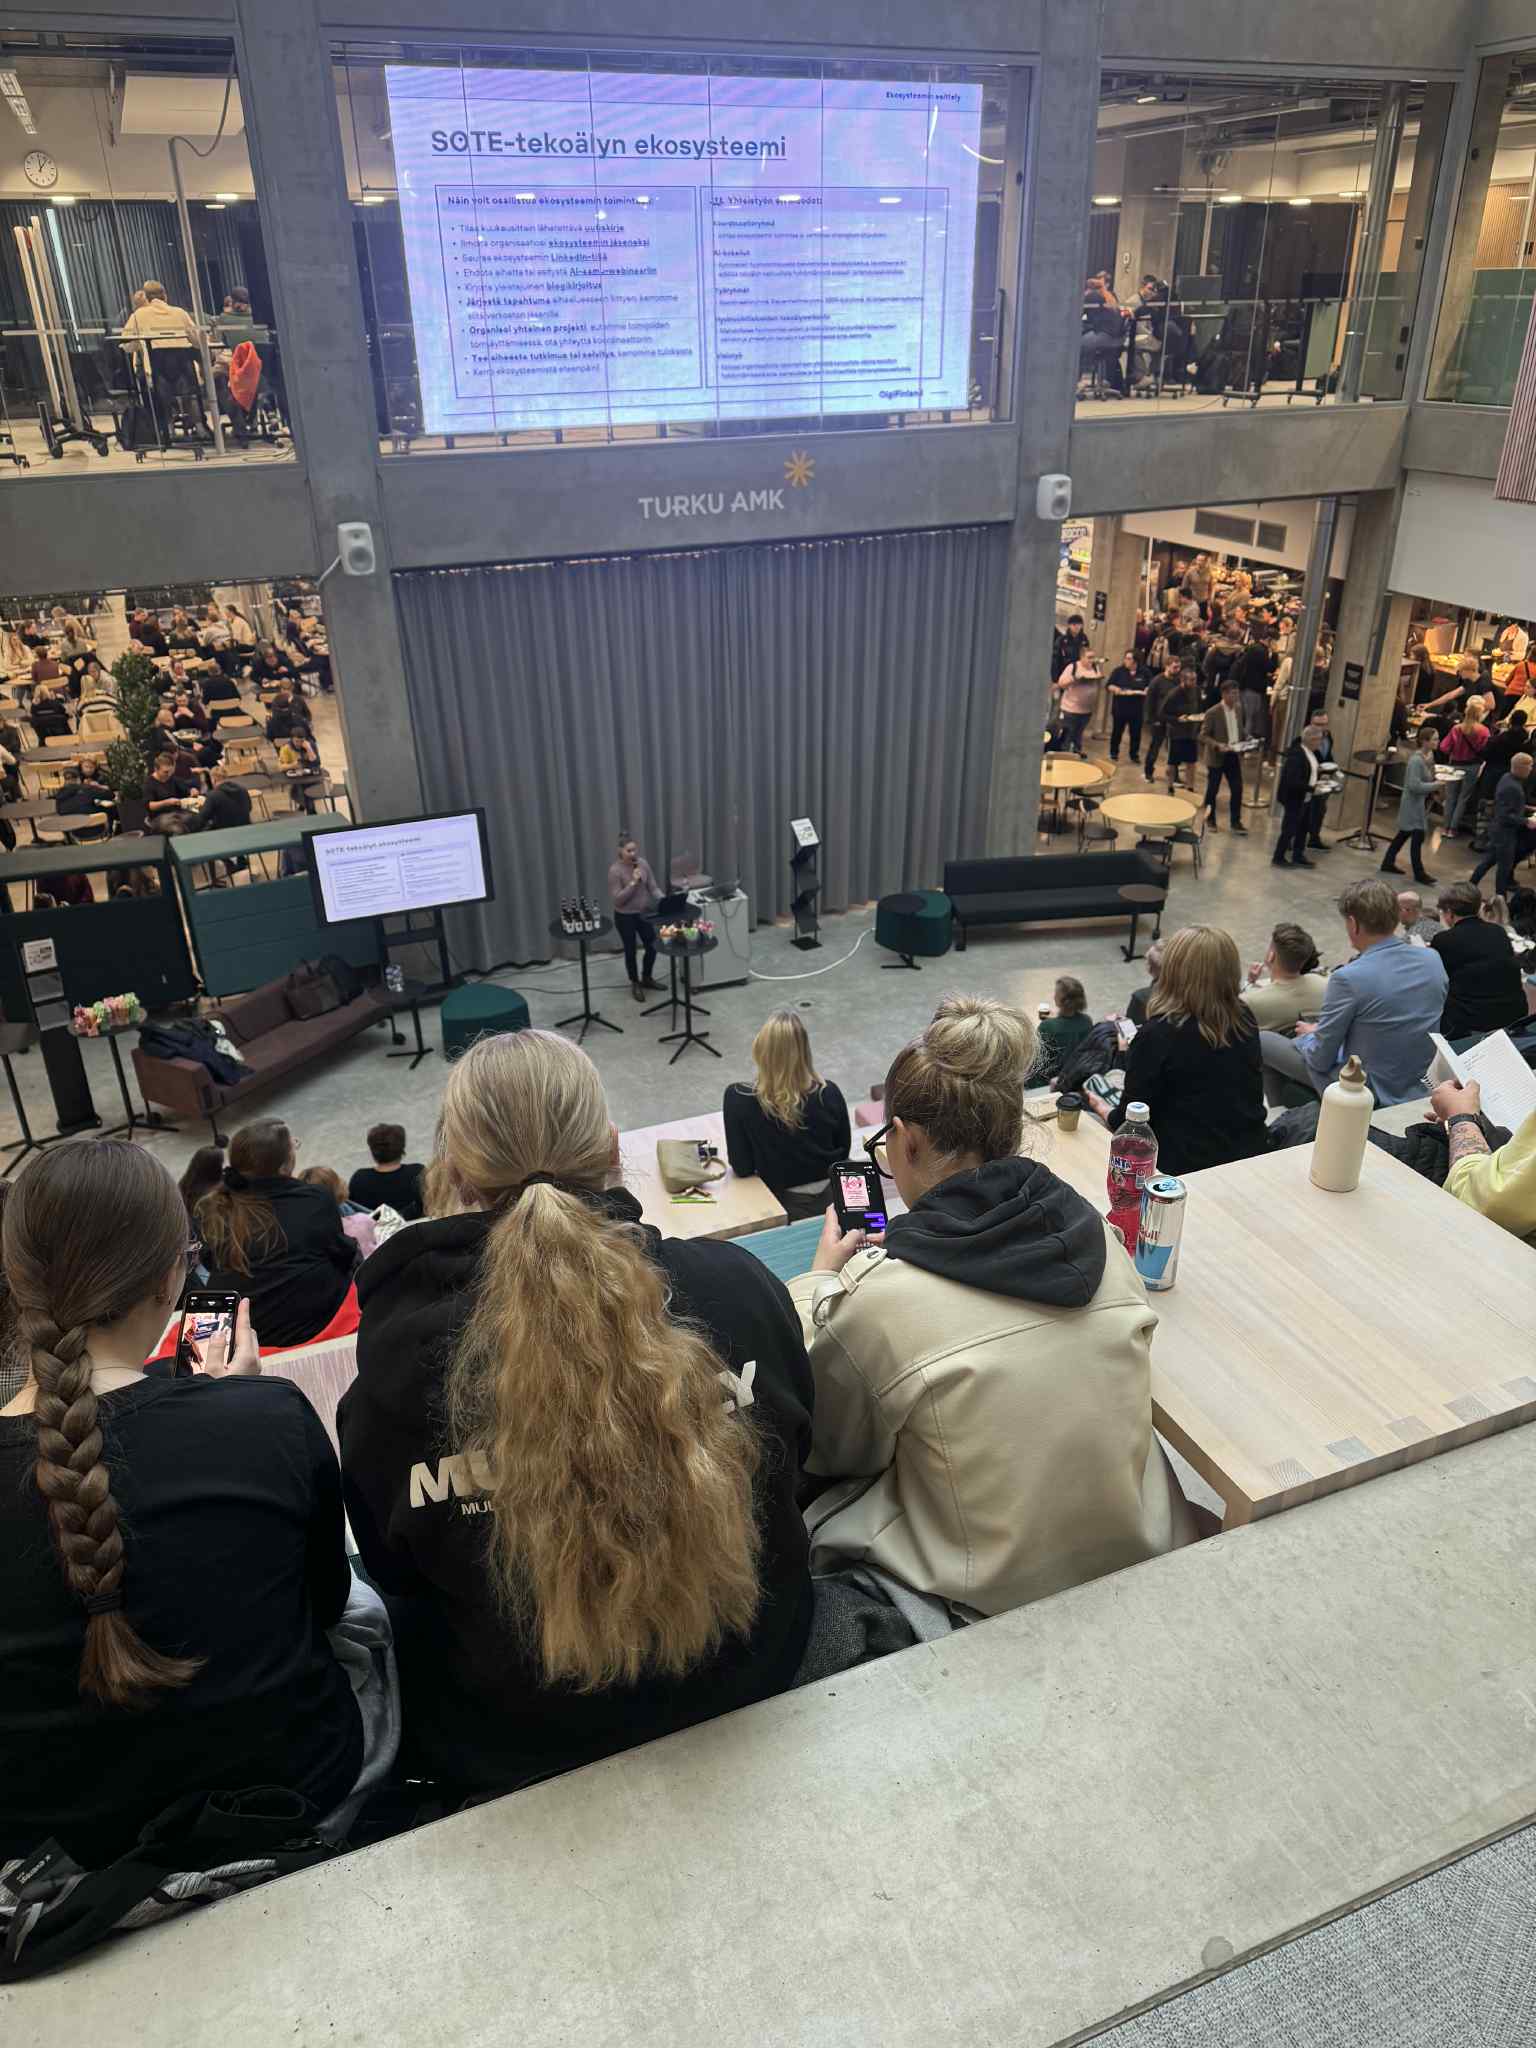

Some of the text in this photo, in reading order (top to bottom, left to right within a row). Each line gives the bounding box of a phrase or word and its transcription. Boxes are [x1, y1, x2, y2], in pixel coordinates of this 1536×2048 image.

[431, 130, 786, 160] SOTE-tekoälyn ekosysteemi
[448, 195, 470, 205] Näin
[603, 196, 654, 206] toimint
[637, 488, 785, 519] TURKU AMK
[461, 1500, 497, 1516] MUL
